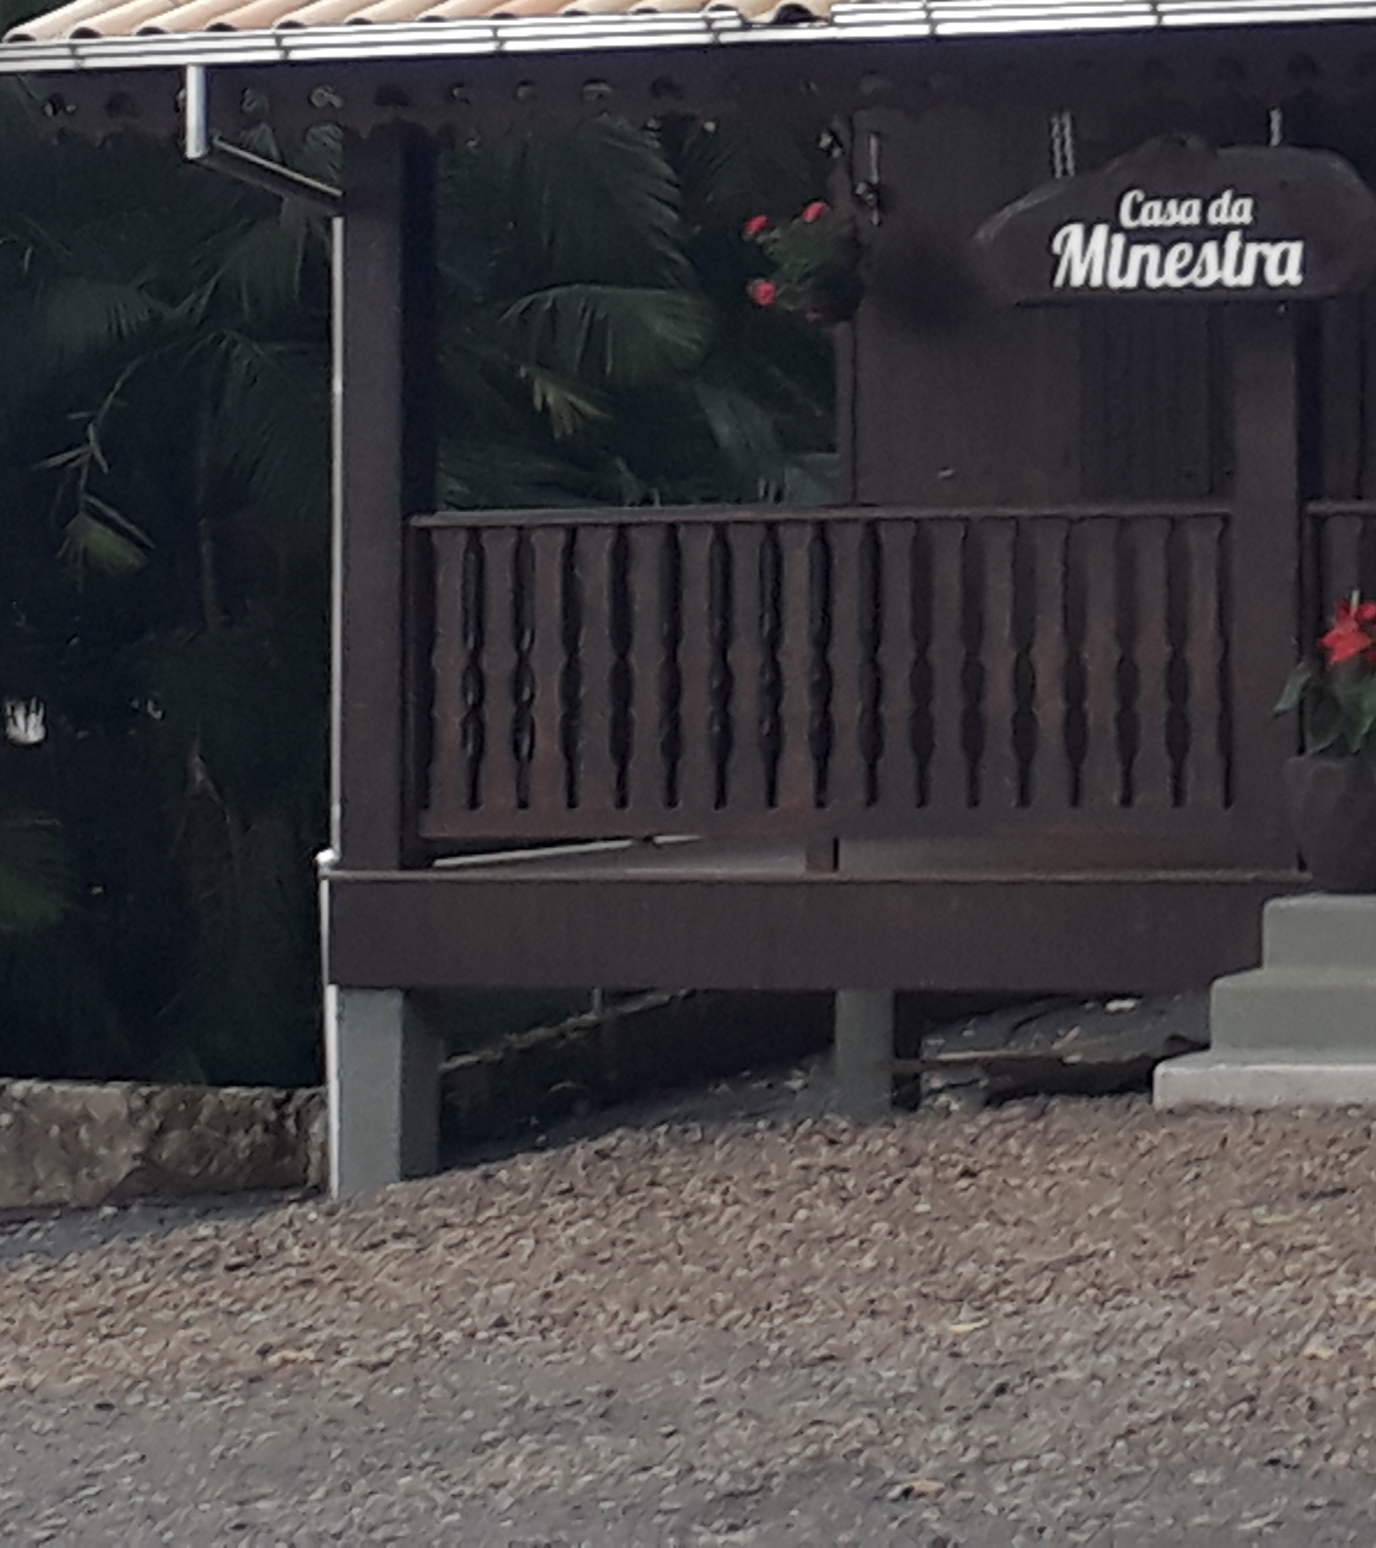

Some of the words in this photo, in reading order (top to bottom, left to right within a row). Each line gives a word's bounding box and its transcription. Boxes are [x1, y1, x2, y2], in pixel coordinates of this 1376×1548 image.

[1119, 189, 1201, 228] Casa
[1207, 189, 1253, 226] da
[1051, 222, 1304, 289] Minestra
